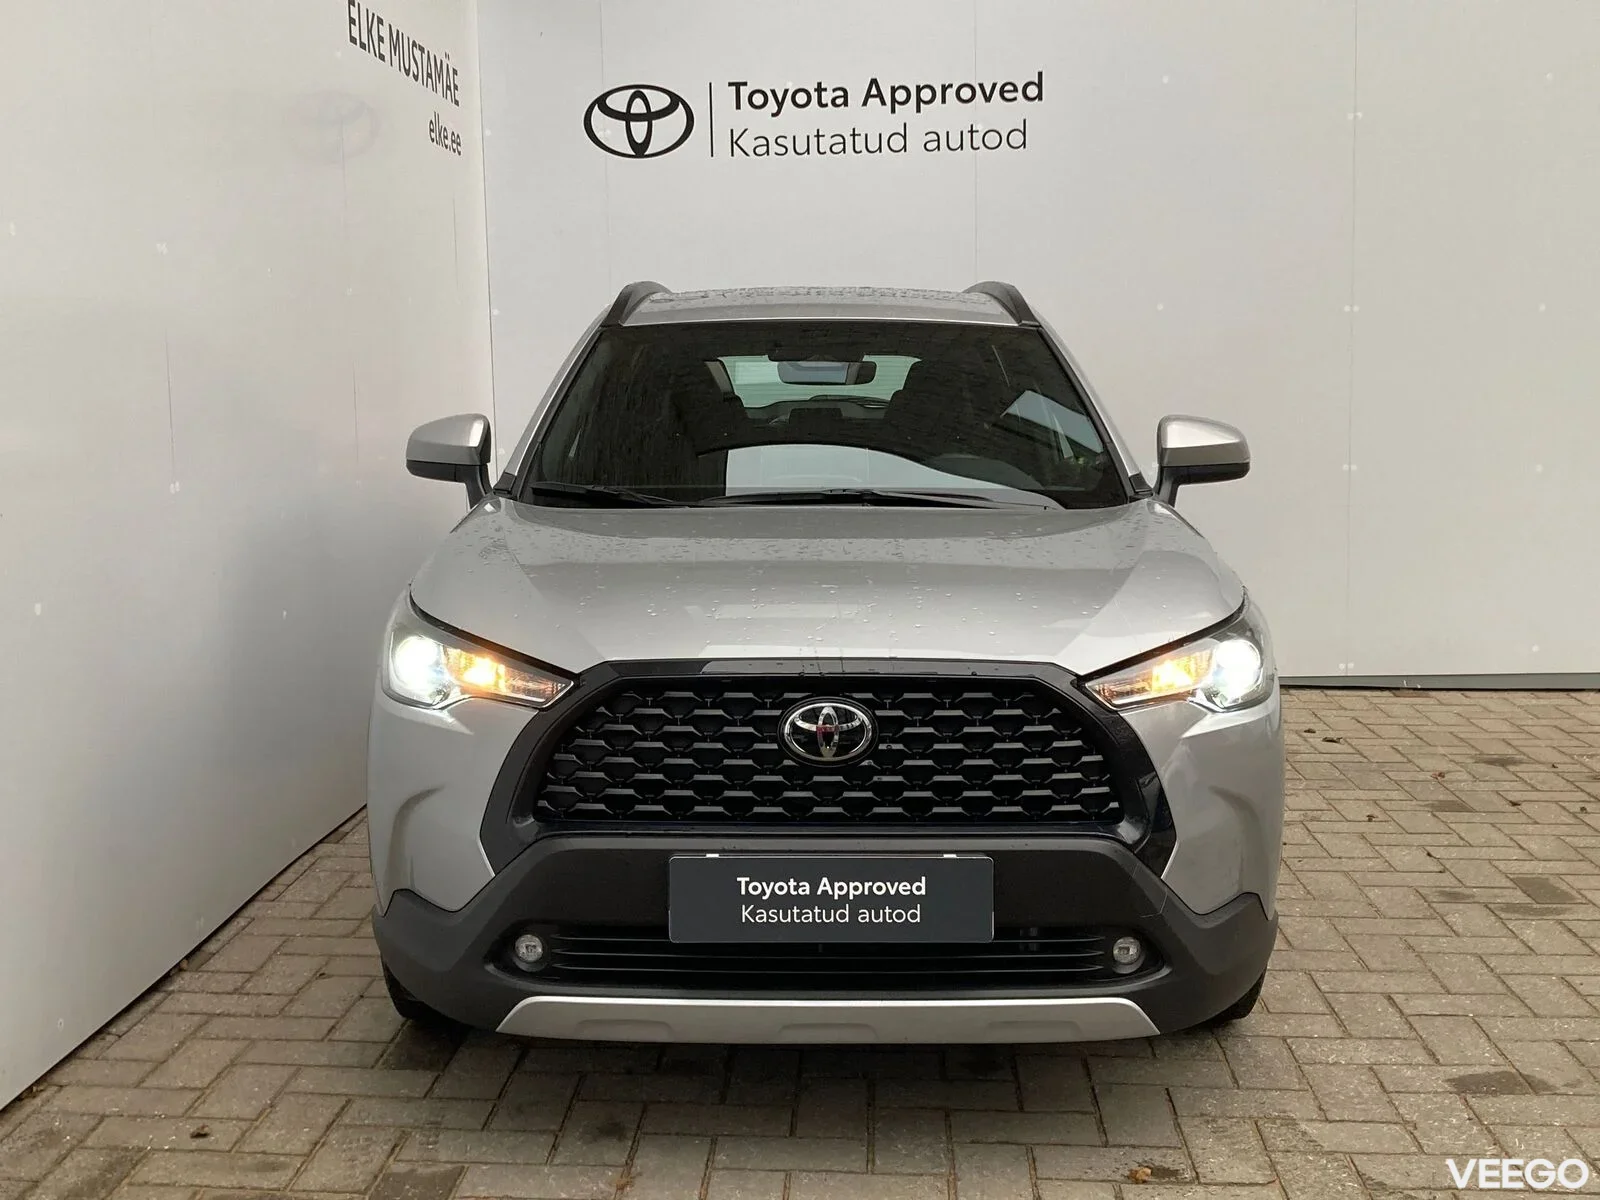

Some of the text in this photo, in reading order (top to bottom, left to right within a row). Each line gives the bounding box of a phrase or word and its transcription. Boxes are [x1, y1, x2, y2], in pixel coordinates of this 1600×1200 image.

[347, 0, 460, 107] ELKE MUSTAMÄE
[728, 71, 1044, 117] Toyota Approved
[428, 111, 462, 156] elke.ee
[730, 118, 1028, 158] Kasutatud autod
[737, 876, 926, 900] Toyota Approved
[741, 904, 921, 923] Kasutatud autod
